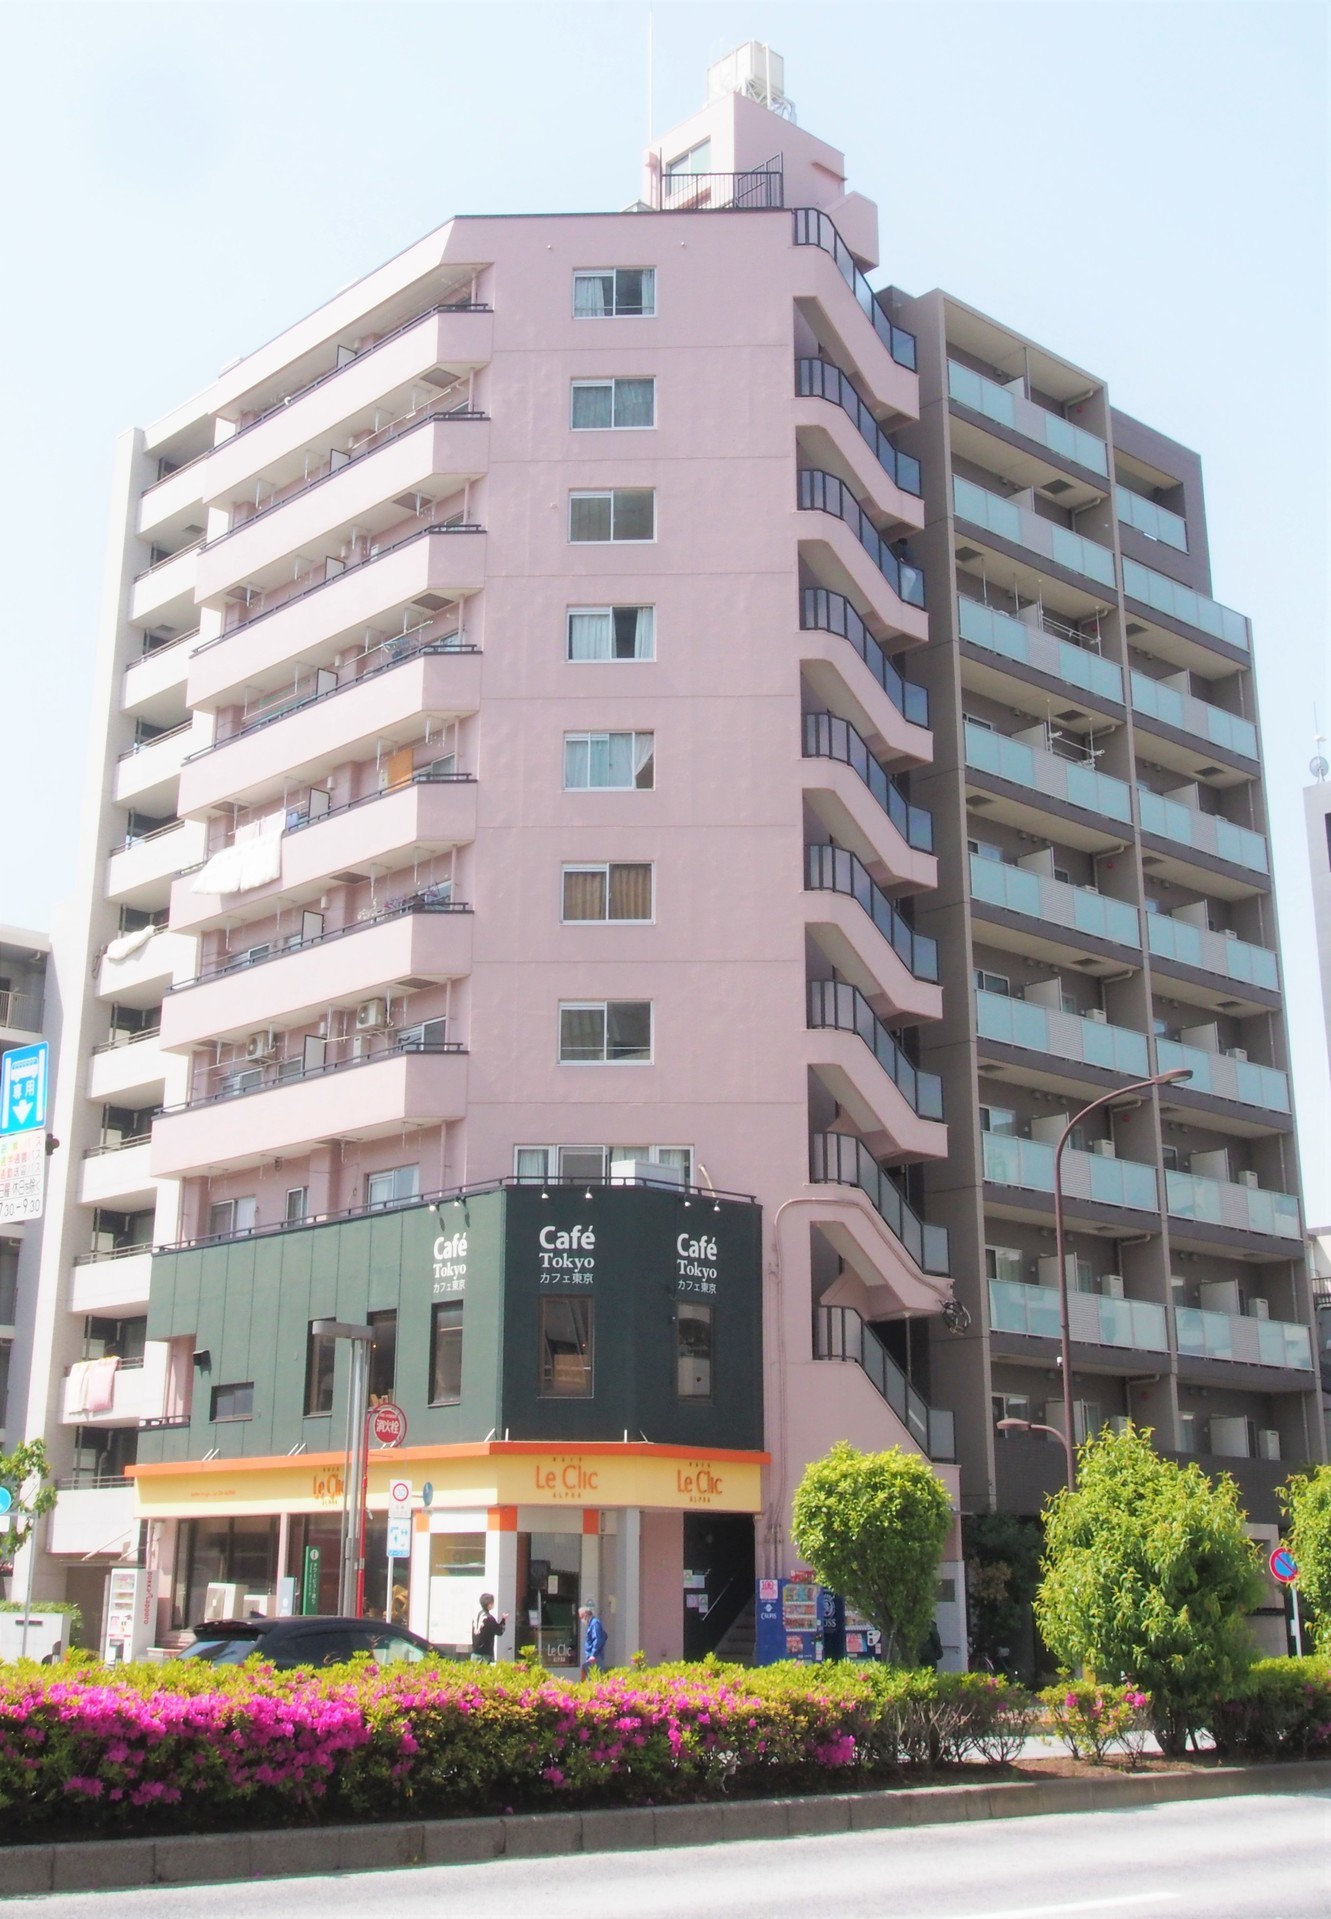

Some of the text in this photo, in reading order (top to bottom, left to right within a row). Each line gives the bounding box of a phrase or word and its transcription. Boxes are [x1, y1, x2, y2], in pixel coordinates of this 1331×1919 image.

[12, 1079, 35, 1099] 専用
[433, 1232, 468, 1261] Café
[539, 1225, 596, 1251] Café
[677, 1233, 718, 1261] Café
[433, 1262, 467, 1280] Tokyo
[539, 1253, 595, 1273] Tokyo
[677, 1259, 717, 1280] Tokyo
[433, 1279, 466, 1294] カフェ東京
[539, 1273, 594, 1284] カフェ東京
[677, 1279, 717, 1295] カフェ東京
[376, 1419, 400, 1434] 消火栓
[313, 1474, 325, 1496] Le
[536, 1464, 599, 1490] Le Clic
[677, 1469, 723, 1494] Le Clic
[547, 1643, 573, 1657] Le Clic
